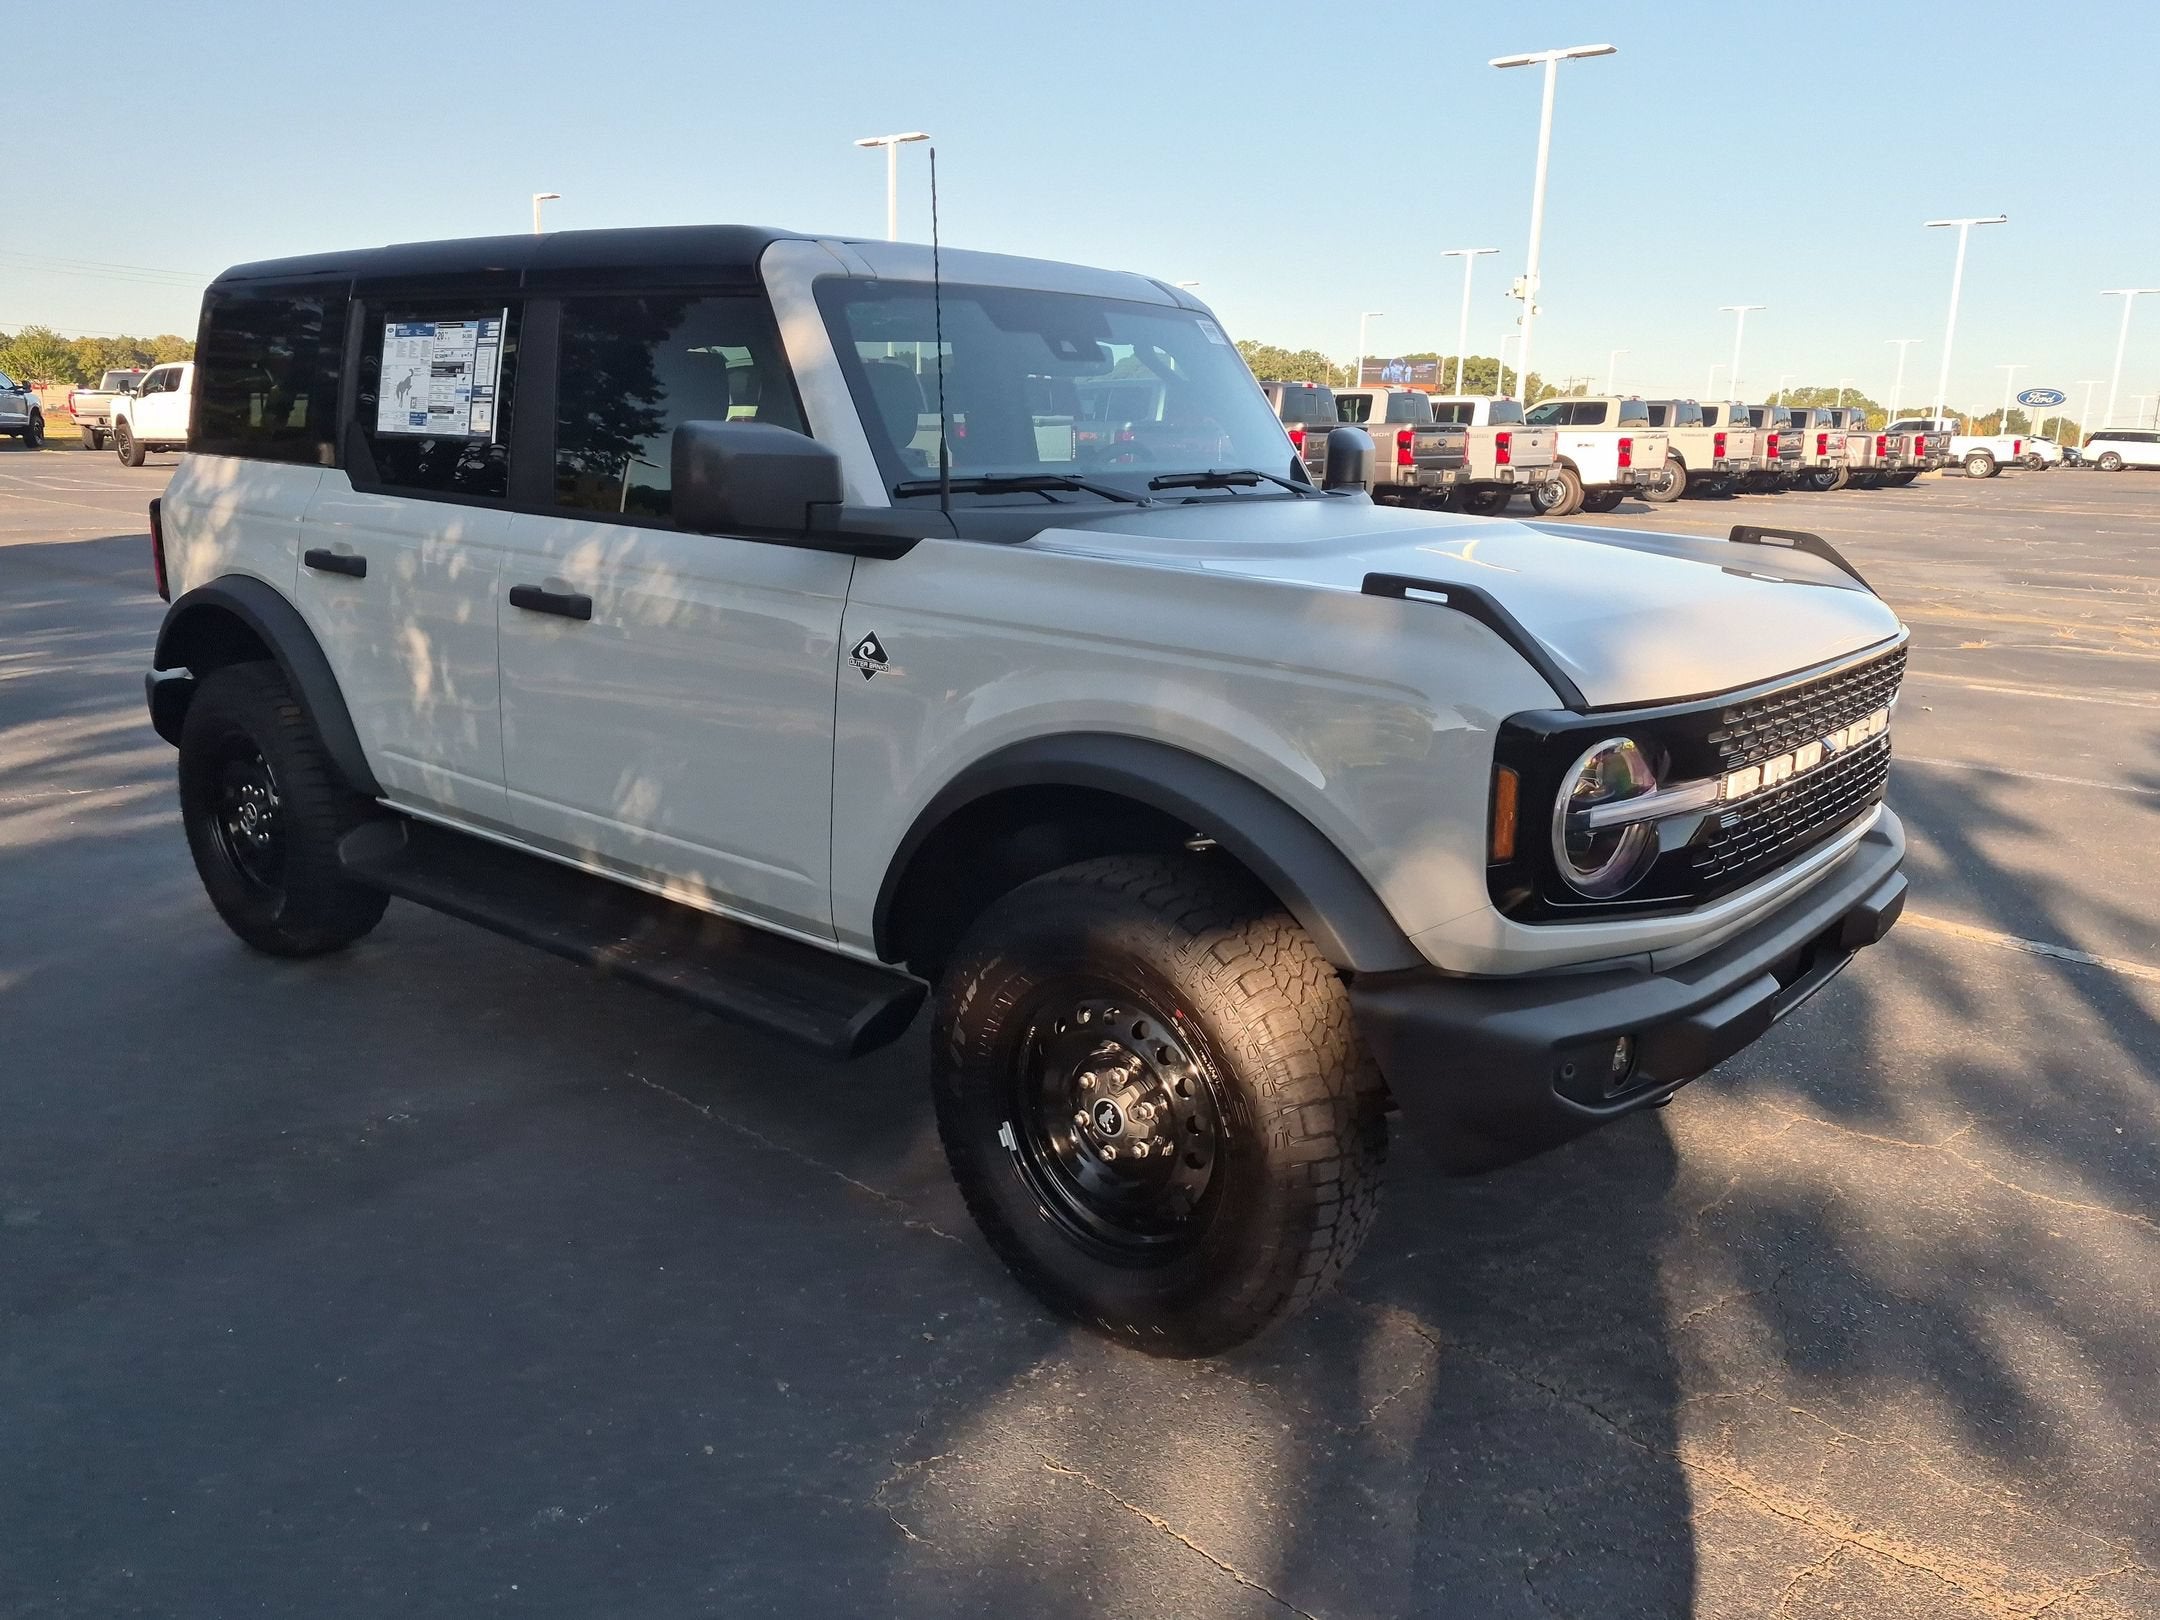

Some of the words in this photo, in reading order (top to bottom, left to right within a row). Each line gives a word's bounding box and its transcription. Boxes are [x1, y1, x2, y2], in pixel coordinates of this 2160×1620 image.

[2025, 391, 2057, 404] Ford
[849, 659, 868, 668] OUTER
[868, 662, 888, 671] BANKS
[1726, 706, 1889, 800] BRONCO
